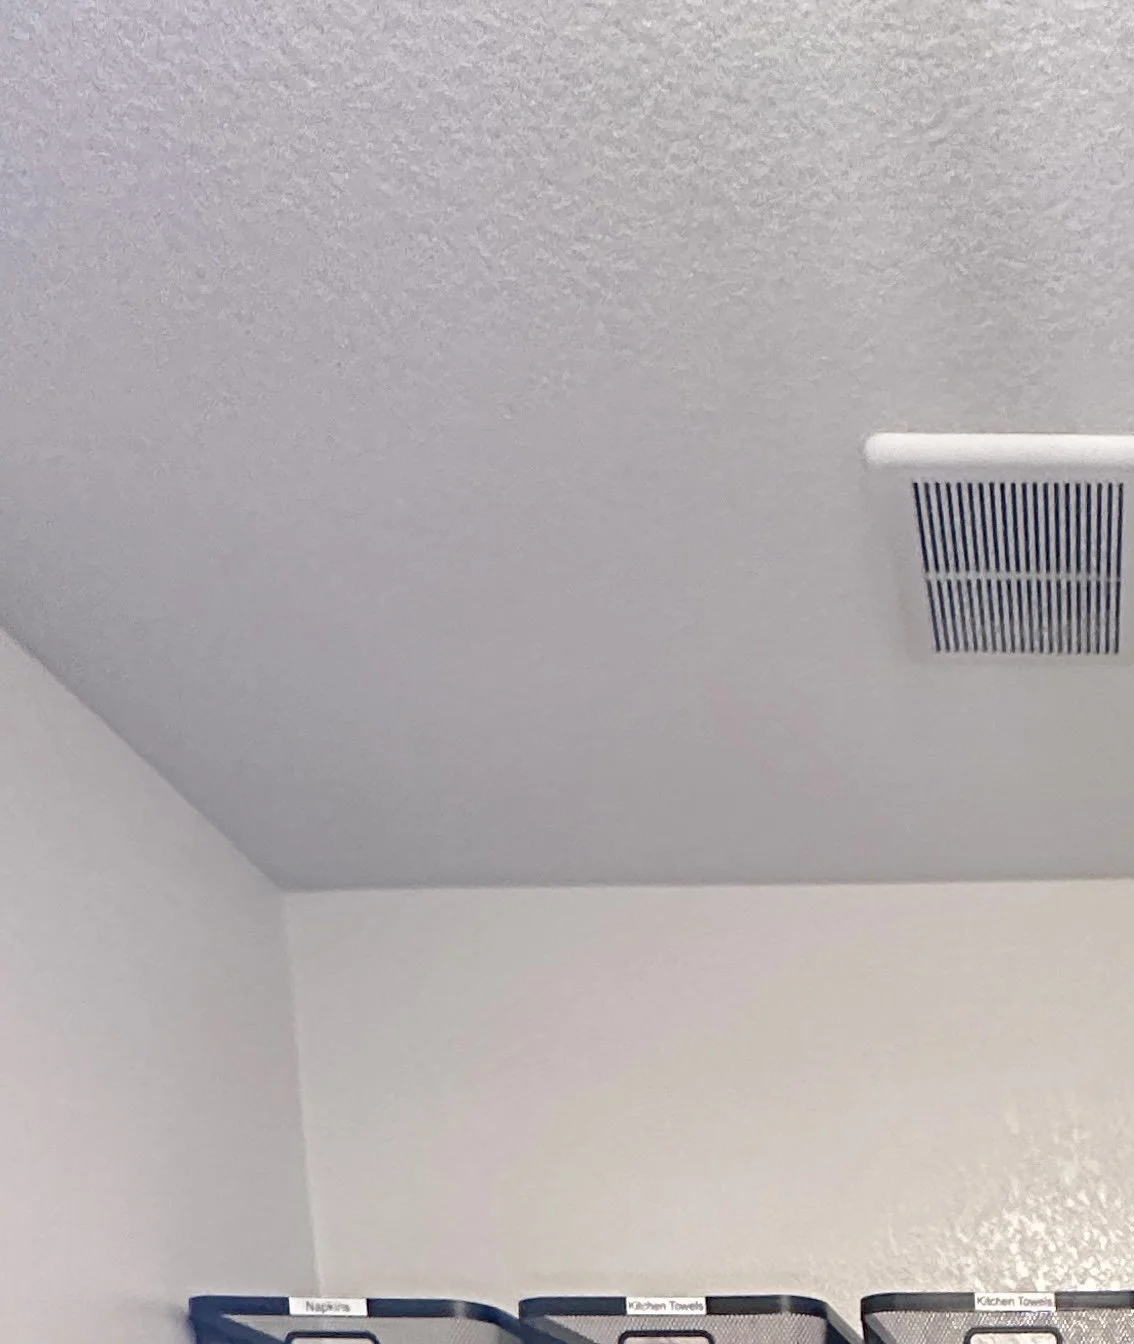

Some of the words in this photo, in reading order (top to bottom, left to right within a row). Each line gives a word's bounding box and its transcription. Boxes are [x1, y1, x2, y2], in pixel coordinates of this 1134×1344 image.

[305, 1301, 351, 1313] Napkins
[628, 1301, 667, 1311] Kitchen
[669, 1300, 704, 1311] Towels
[976, 1295, 1016, 1307] Kitchen
[1018, 1295, 1053, 1307] Towels
